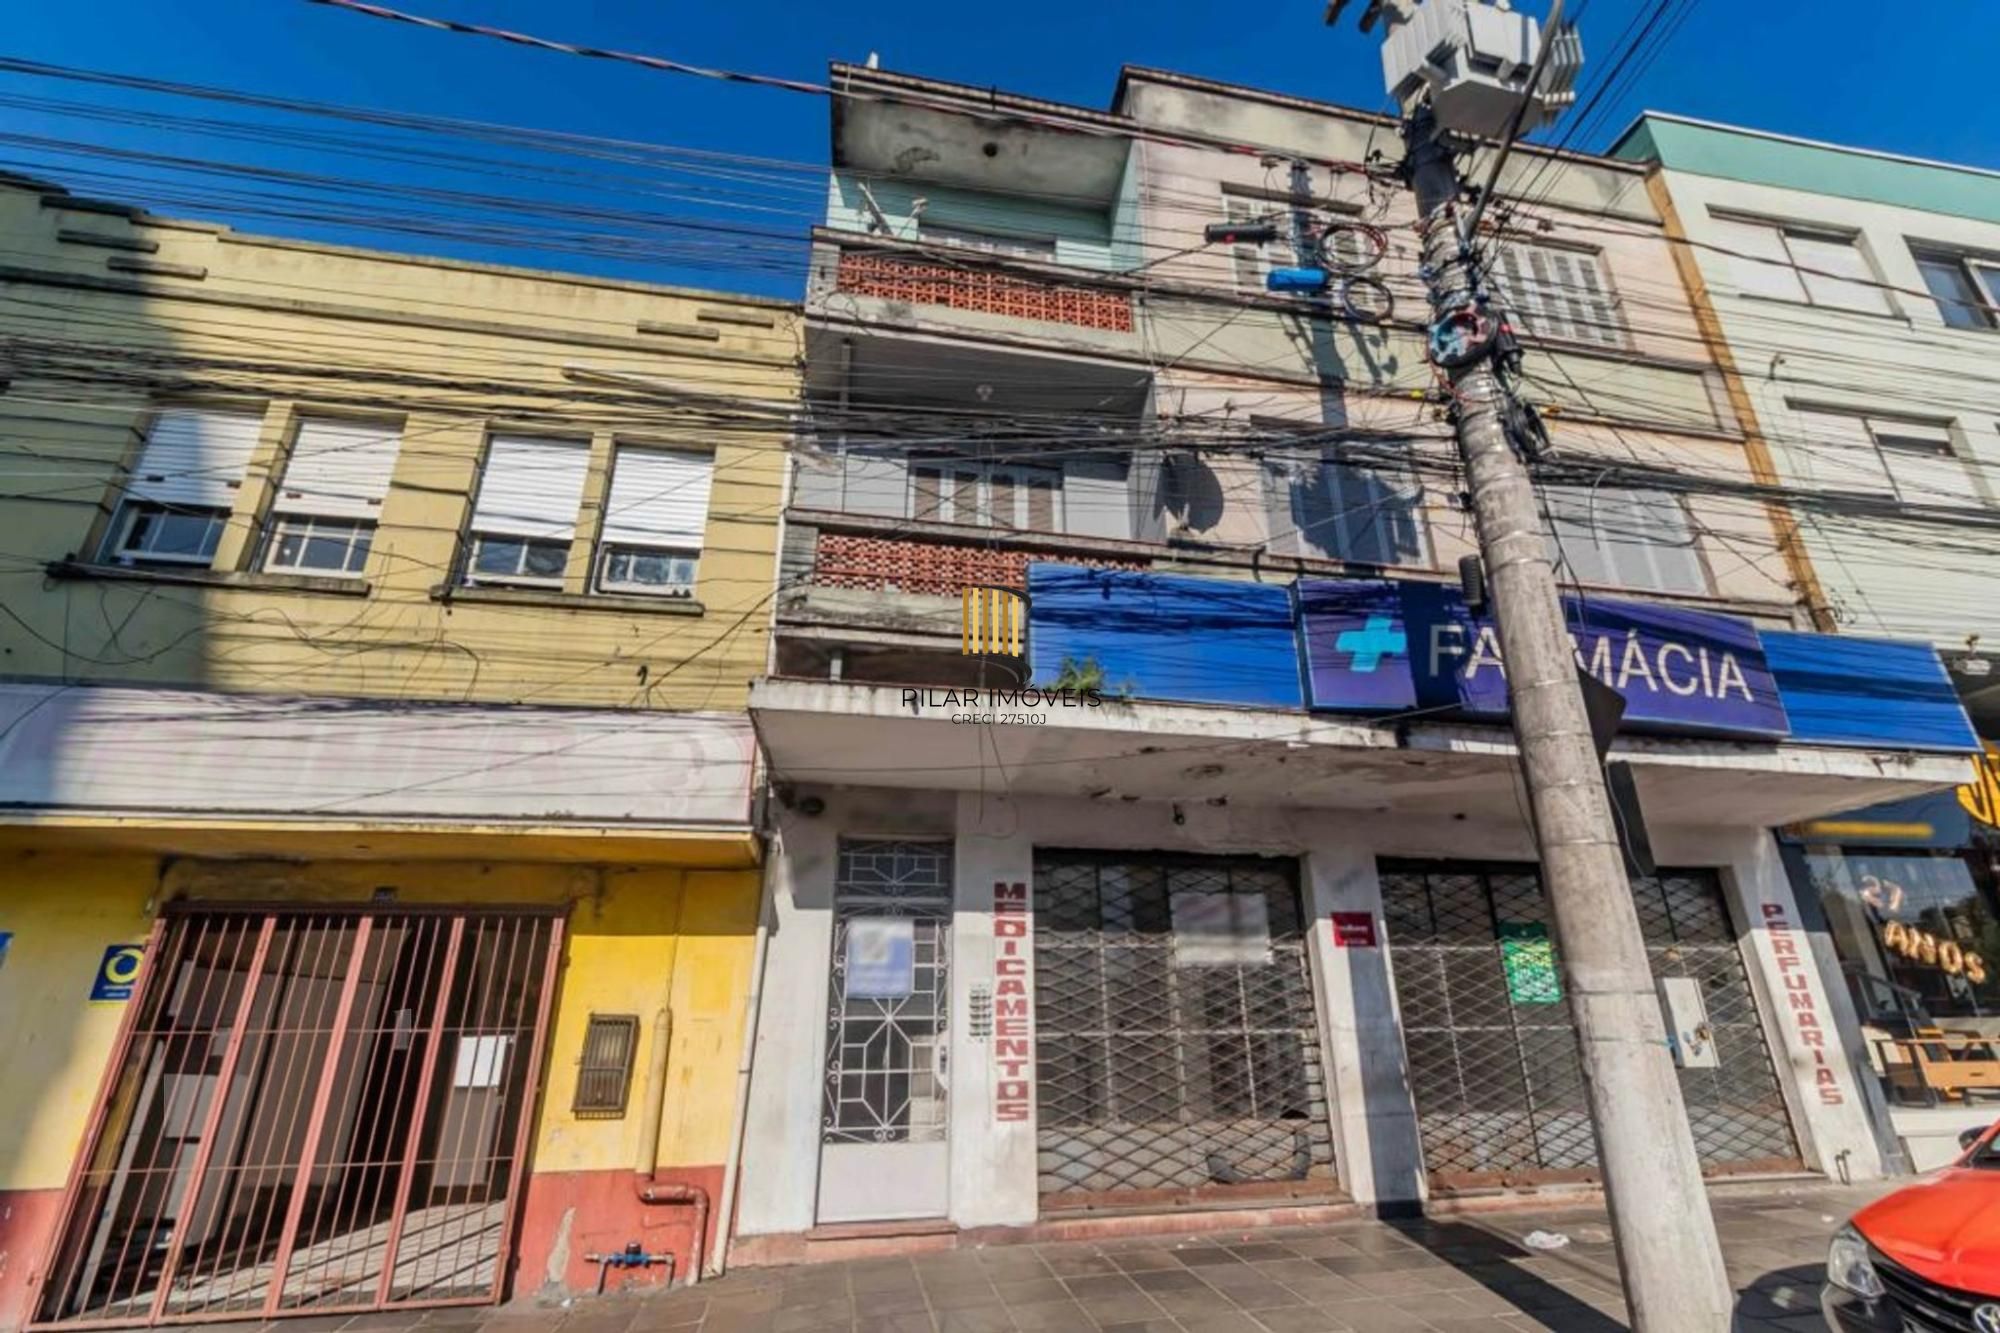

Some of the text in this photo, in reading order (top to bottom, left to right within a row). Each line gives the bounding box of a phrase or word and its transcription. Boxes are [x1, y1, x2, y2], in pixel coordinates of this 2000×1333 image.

[1430, 624, 1754, 701] FAMÁCIA
[994, 882, 1029, 1121] MEDICAMENTOS
[1760, 903, 1844, 1105] PERFUMARIAS
